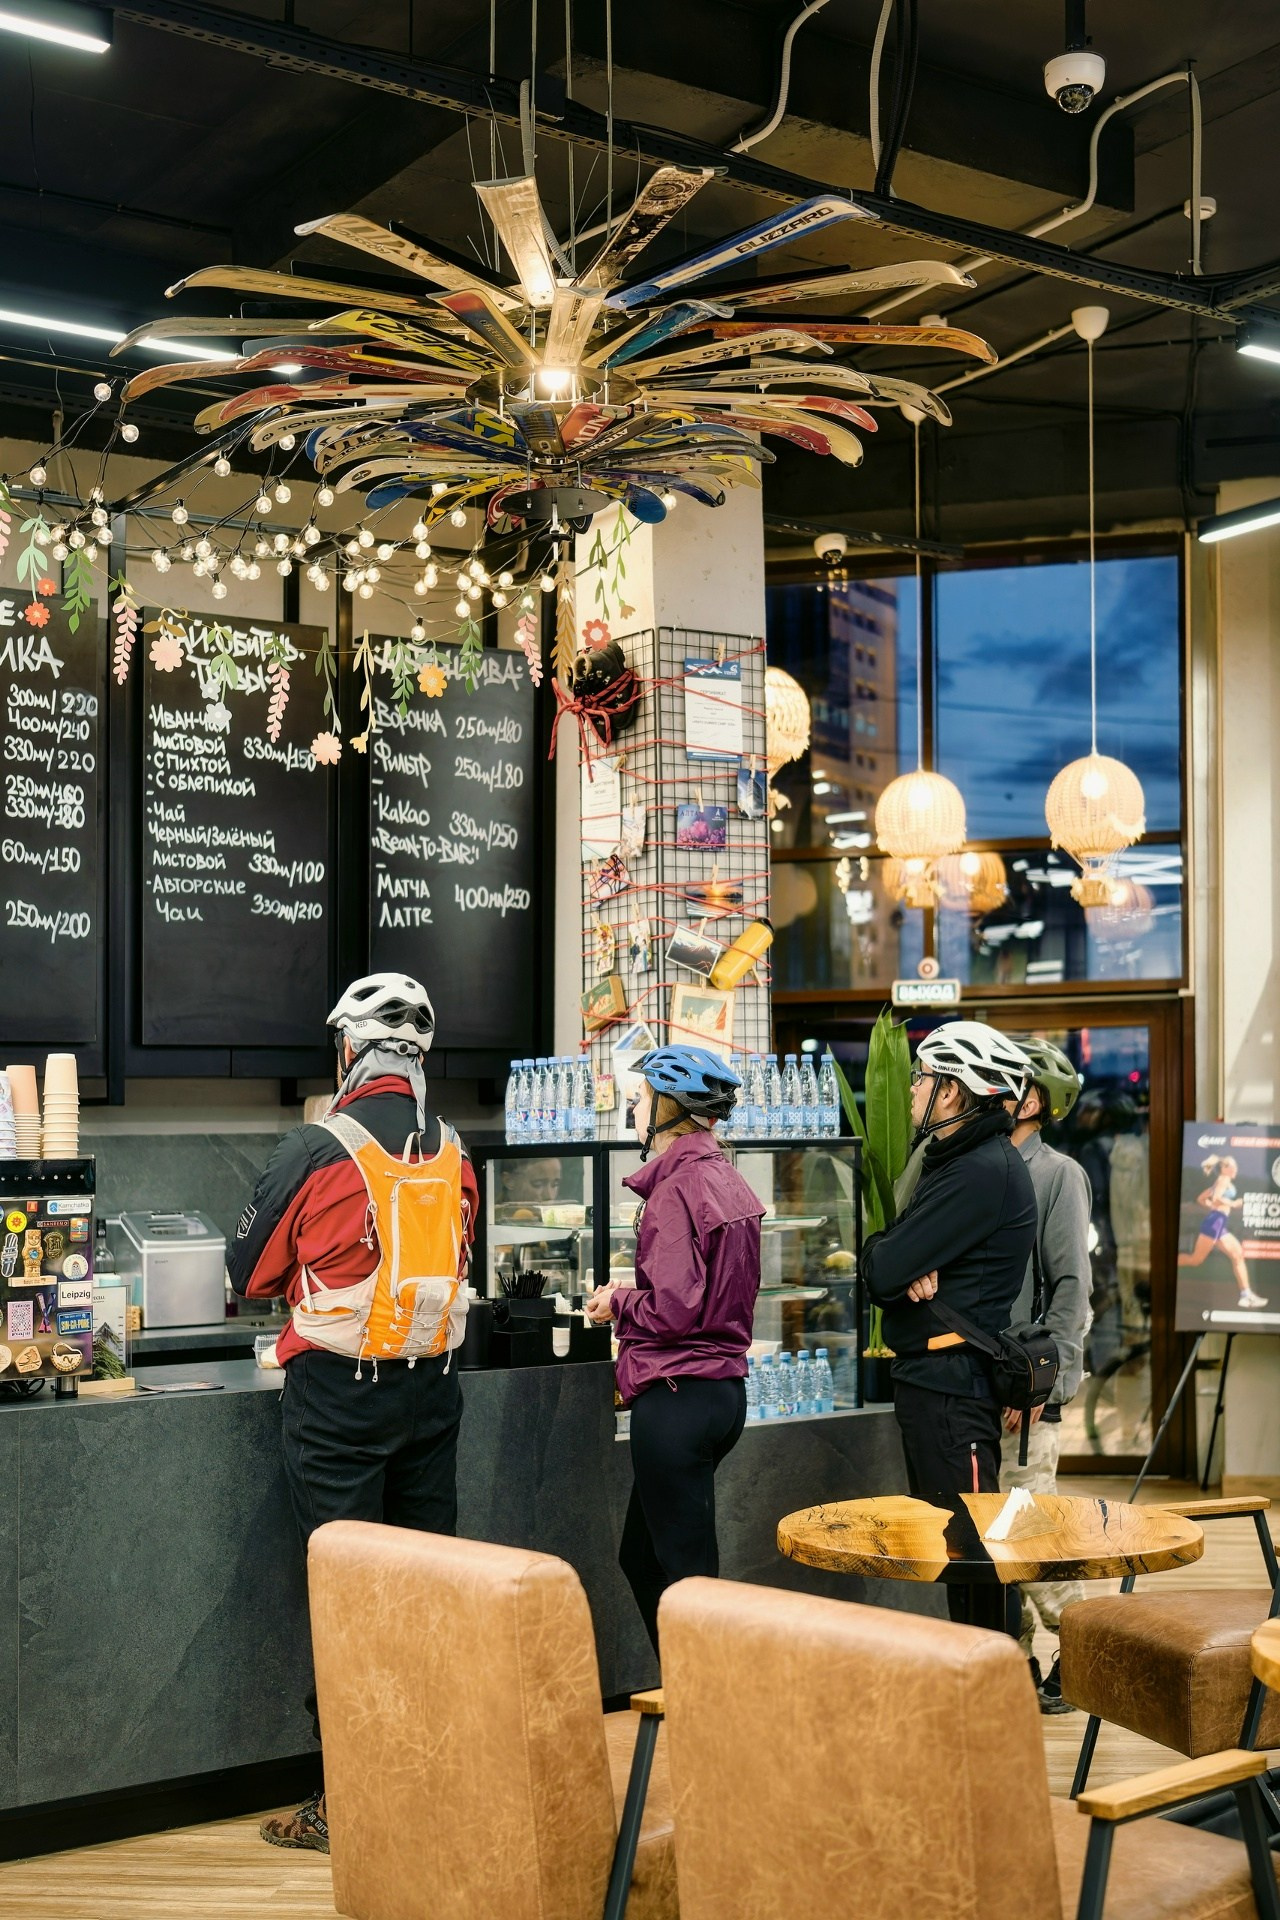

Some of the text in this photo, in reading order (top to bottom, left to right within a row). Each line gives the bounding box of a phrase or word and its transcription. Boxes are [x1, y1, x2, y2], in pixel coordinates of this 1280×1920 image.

[735, 206, 834, 255] BLIZZARD
[731, 370, 846, 383] ROSSIGNOL
[278, 410, 386, 432] ROSSIGNOL
[57, 750, 95, 773] 220
[899, 984, 954, 1001] ВЫХОД
[355, 1020, 368, 1029] KED
[61, 1290, 91, 1301] Leipzig
